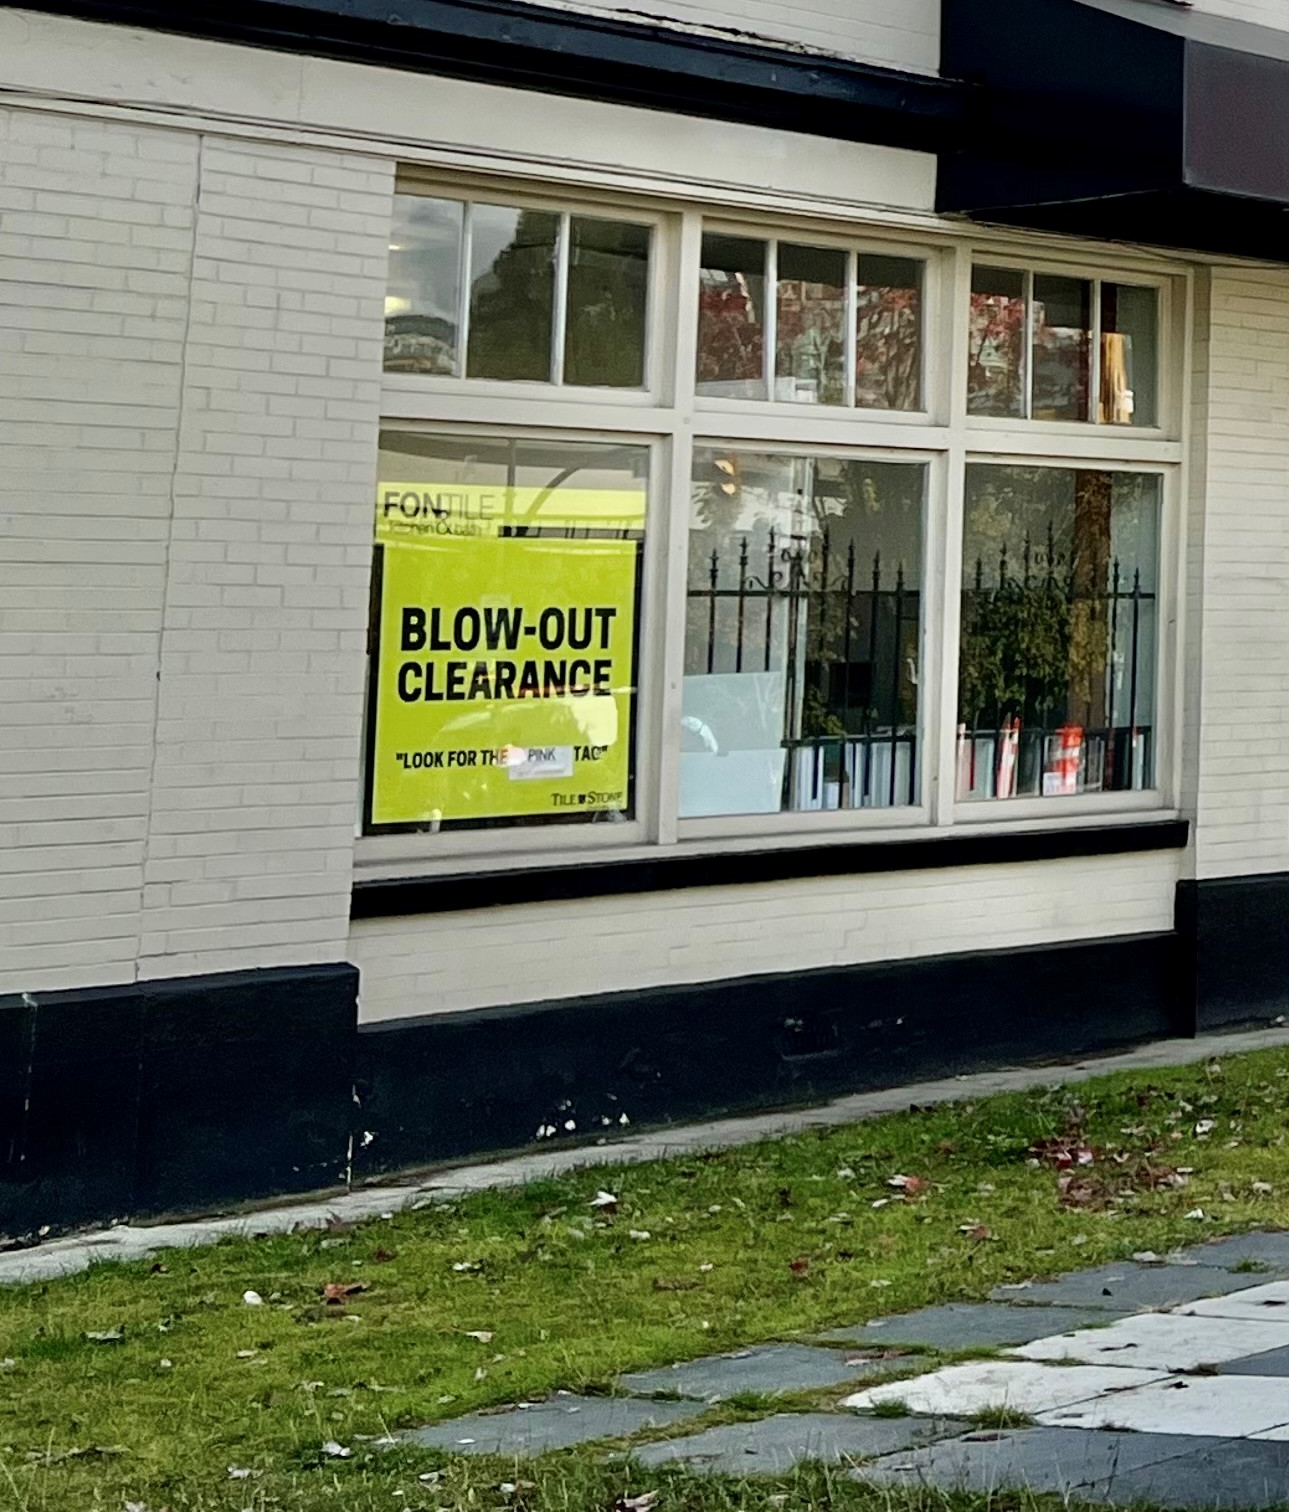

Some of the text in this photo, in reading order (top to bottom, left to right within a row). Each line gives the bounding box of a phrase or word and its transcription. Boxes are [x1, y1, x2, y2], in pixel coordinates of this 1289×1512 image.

[400, 606, 617, 651] BLOW-OUT
[398, 659, 612, 703] CLEARANCE
[448, 750, 476, 767] FOR
[480, 748, 508, 766] THE
[528, 748, 556, 761] PINK
